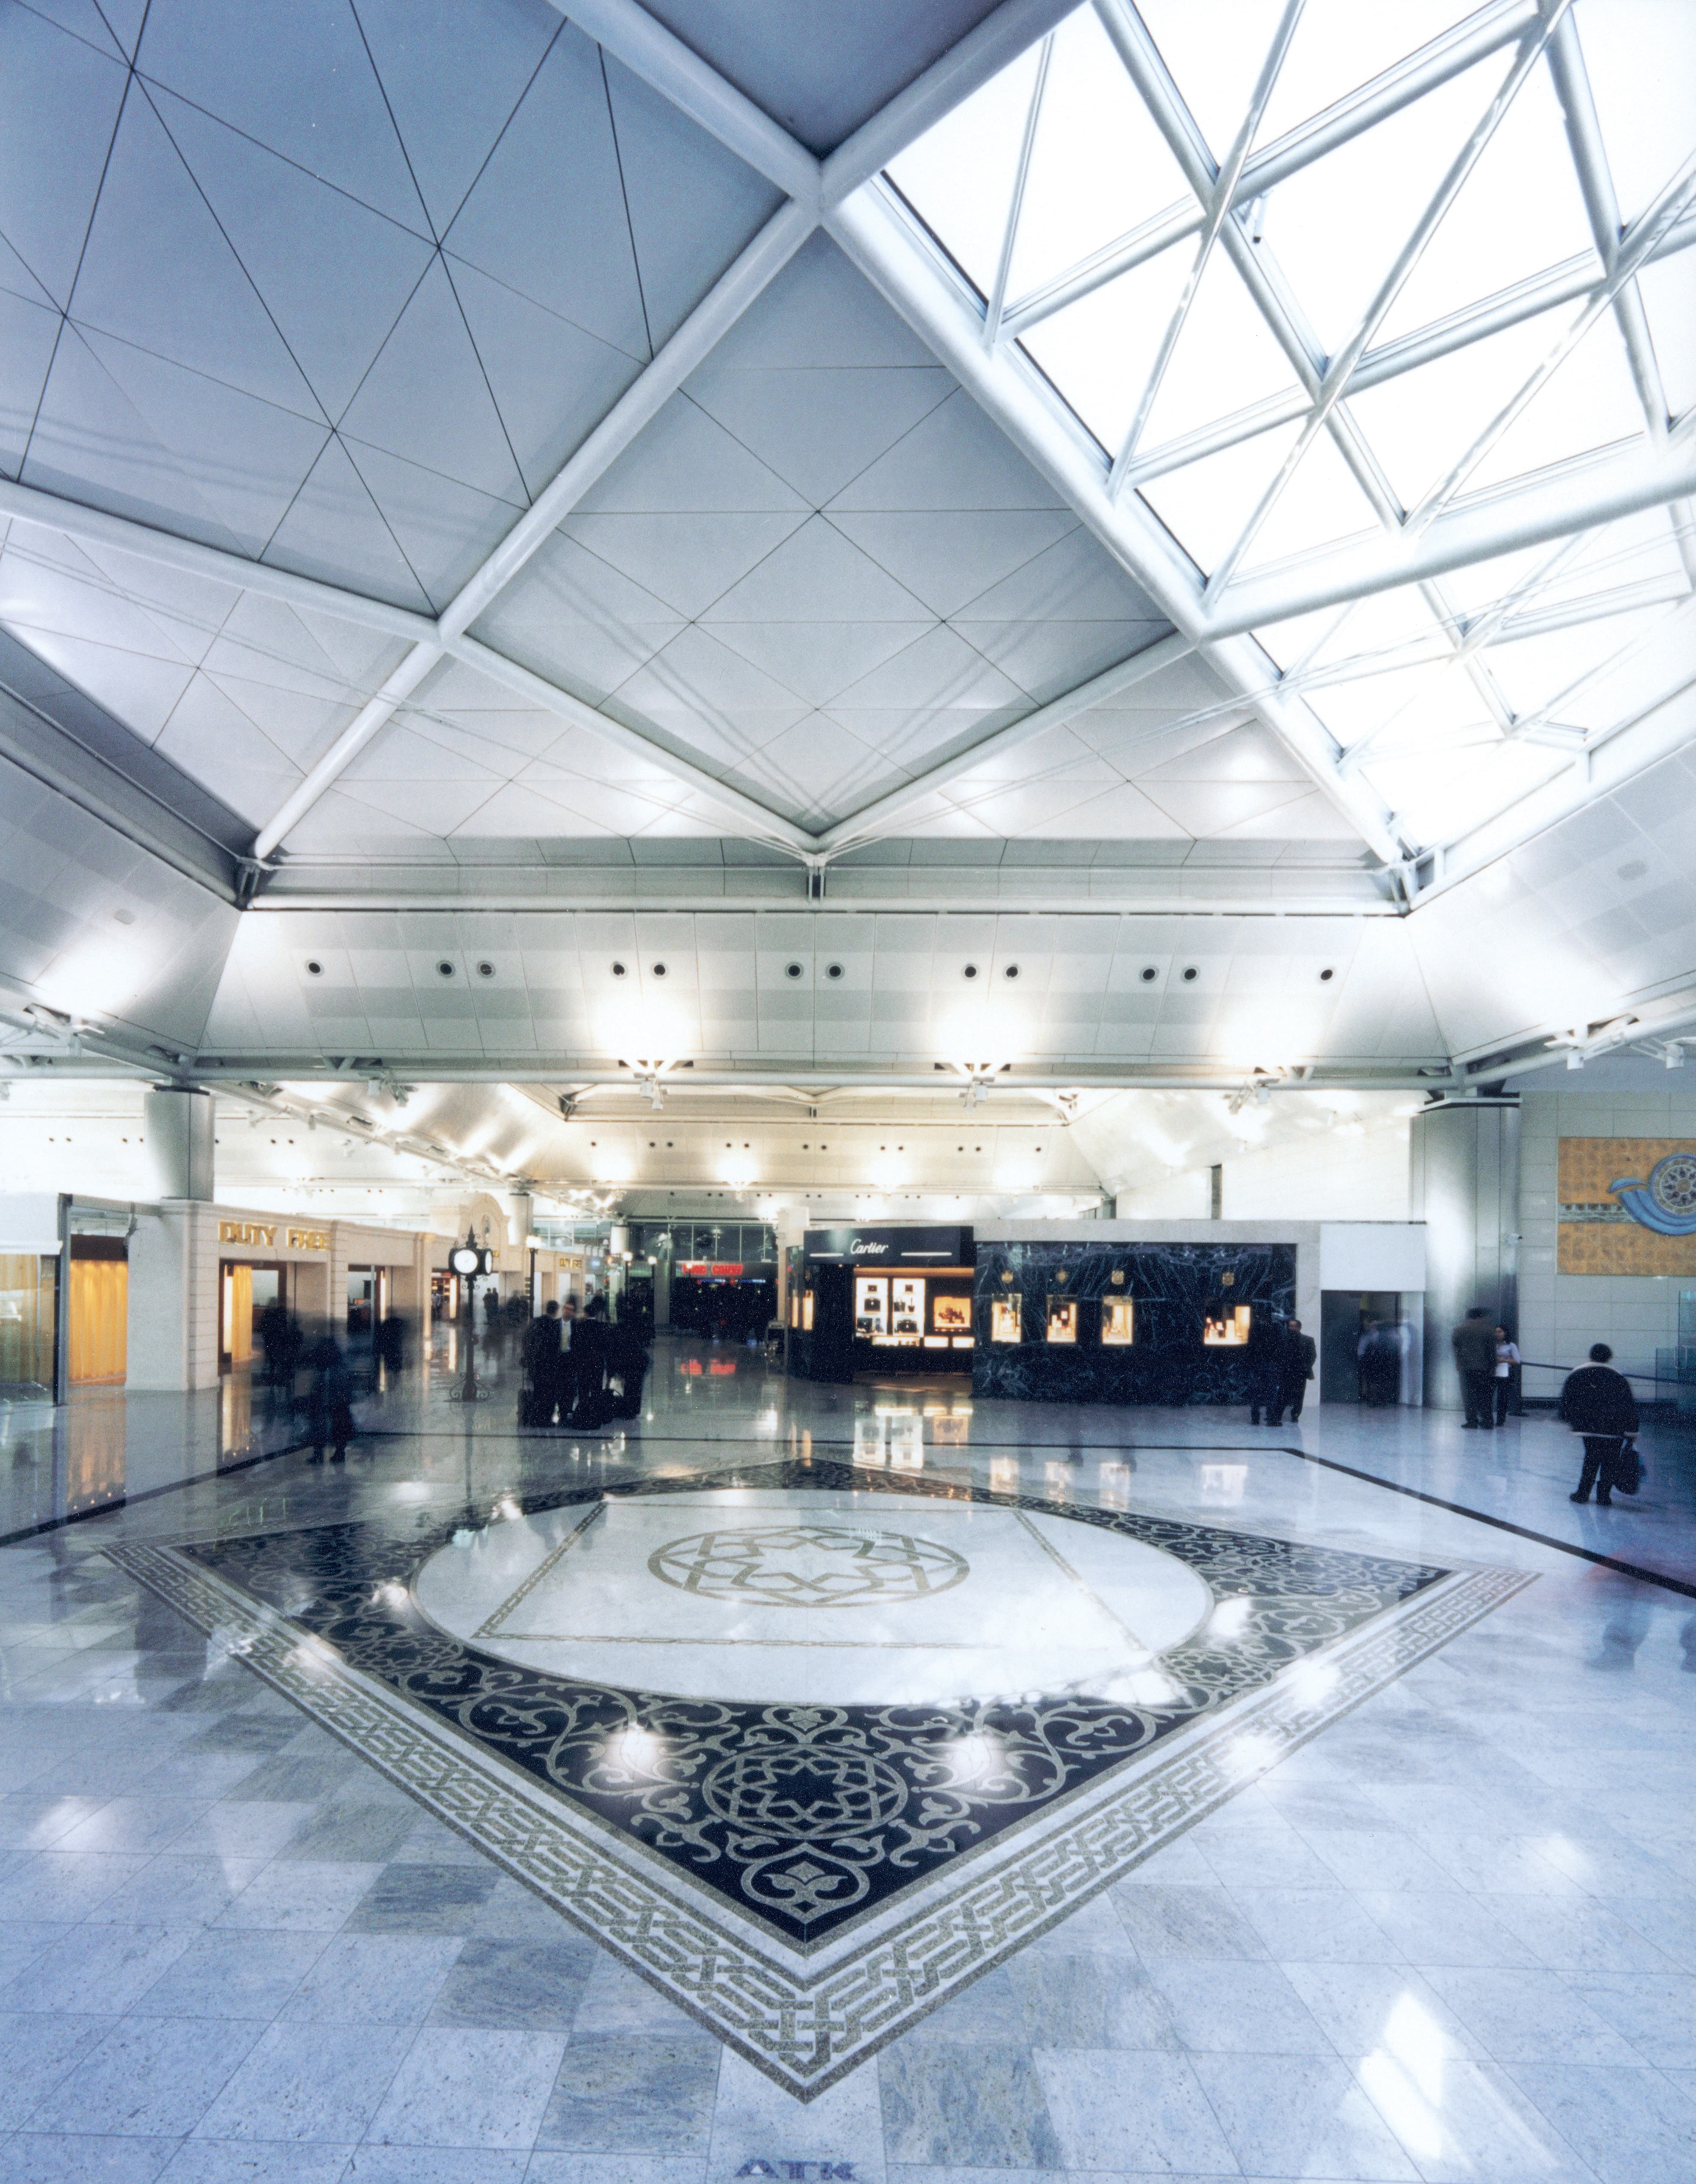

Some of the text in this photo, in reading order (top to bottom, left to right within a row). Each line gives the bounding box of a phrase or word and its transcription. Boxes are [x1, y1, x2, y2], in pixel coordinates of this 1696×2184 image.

[218, 1221, 331, 1250] DUTY FREE
[850, 1238, 889, 1255] Cartier
[734, 2158, 859, 2181] ATK
